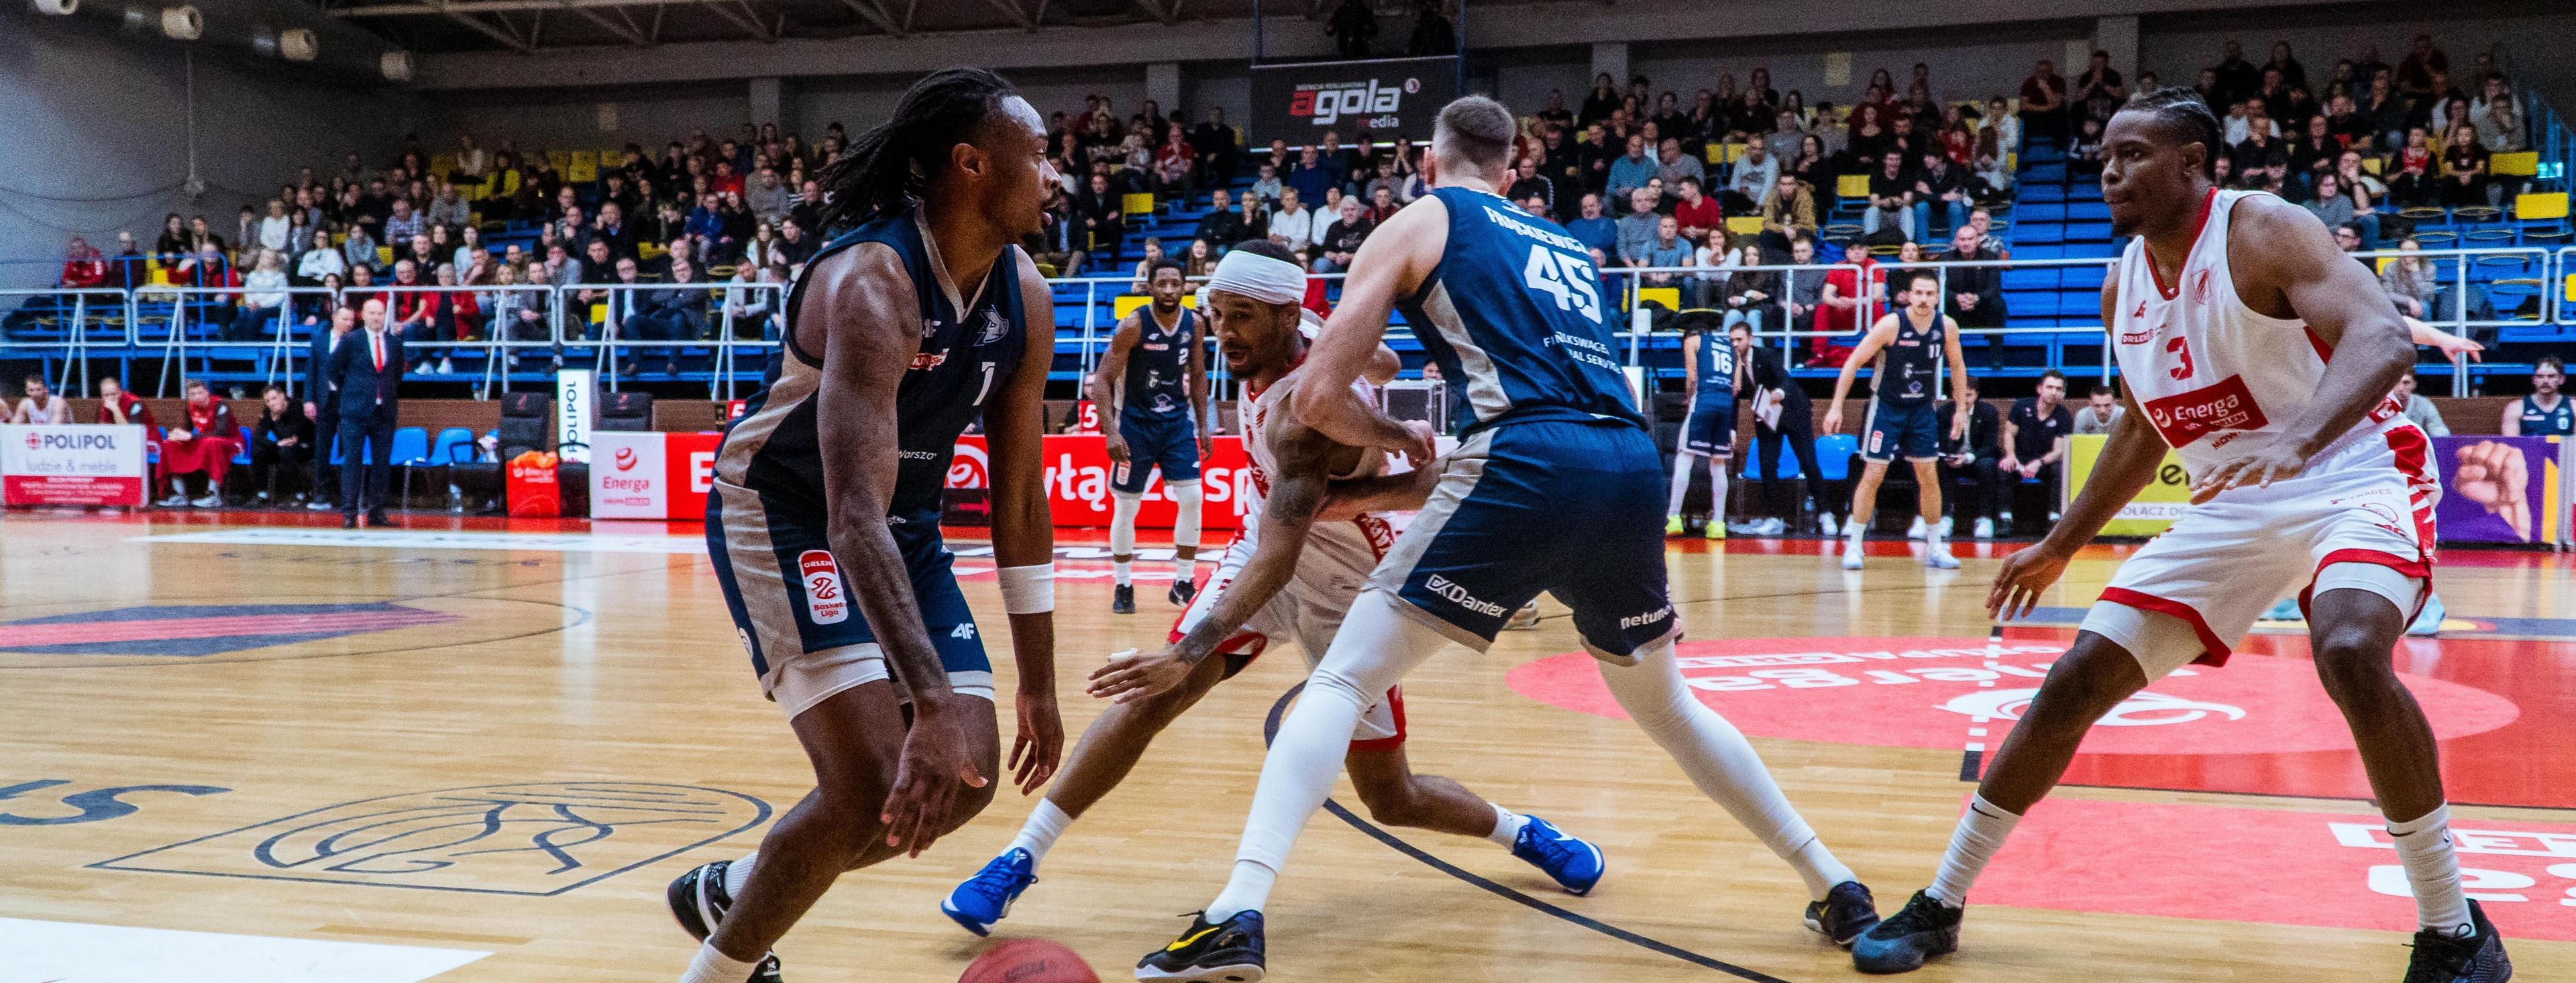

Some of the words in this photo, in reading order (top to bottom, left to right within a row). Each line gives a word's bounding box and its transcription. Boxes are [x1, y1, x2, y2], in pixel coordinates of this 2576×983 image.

[1290, 78, 1401, 125] agola
[1523, 244, 1603, 325] 45
[1179, 348, 1189, 365] 2
[1712, 350, 1733, 374] 16
[2166, 336, 2194, 380] 3
[566, 380, 578, 453] POLIPOL
[1083, 404, 1099, 428] 5
[2174, 394, 2239, 421] Energa
[44, 435, 115, 450] POLIPOL
[603, 476, 649, 493] Energa
[804, 560, 833, 568] ORLEN
[814, 603, 844, 611] Basket
[1446, 585, 1508, 617] Dantex
[951, 623, 974, 639] 4F
